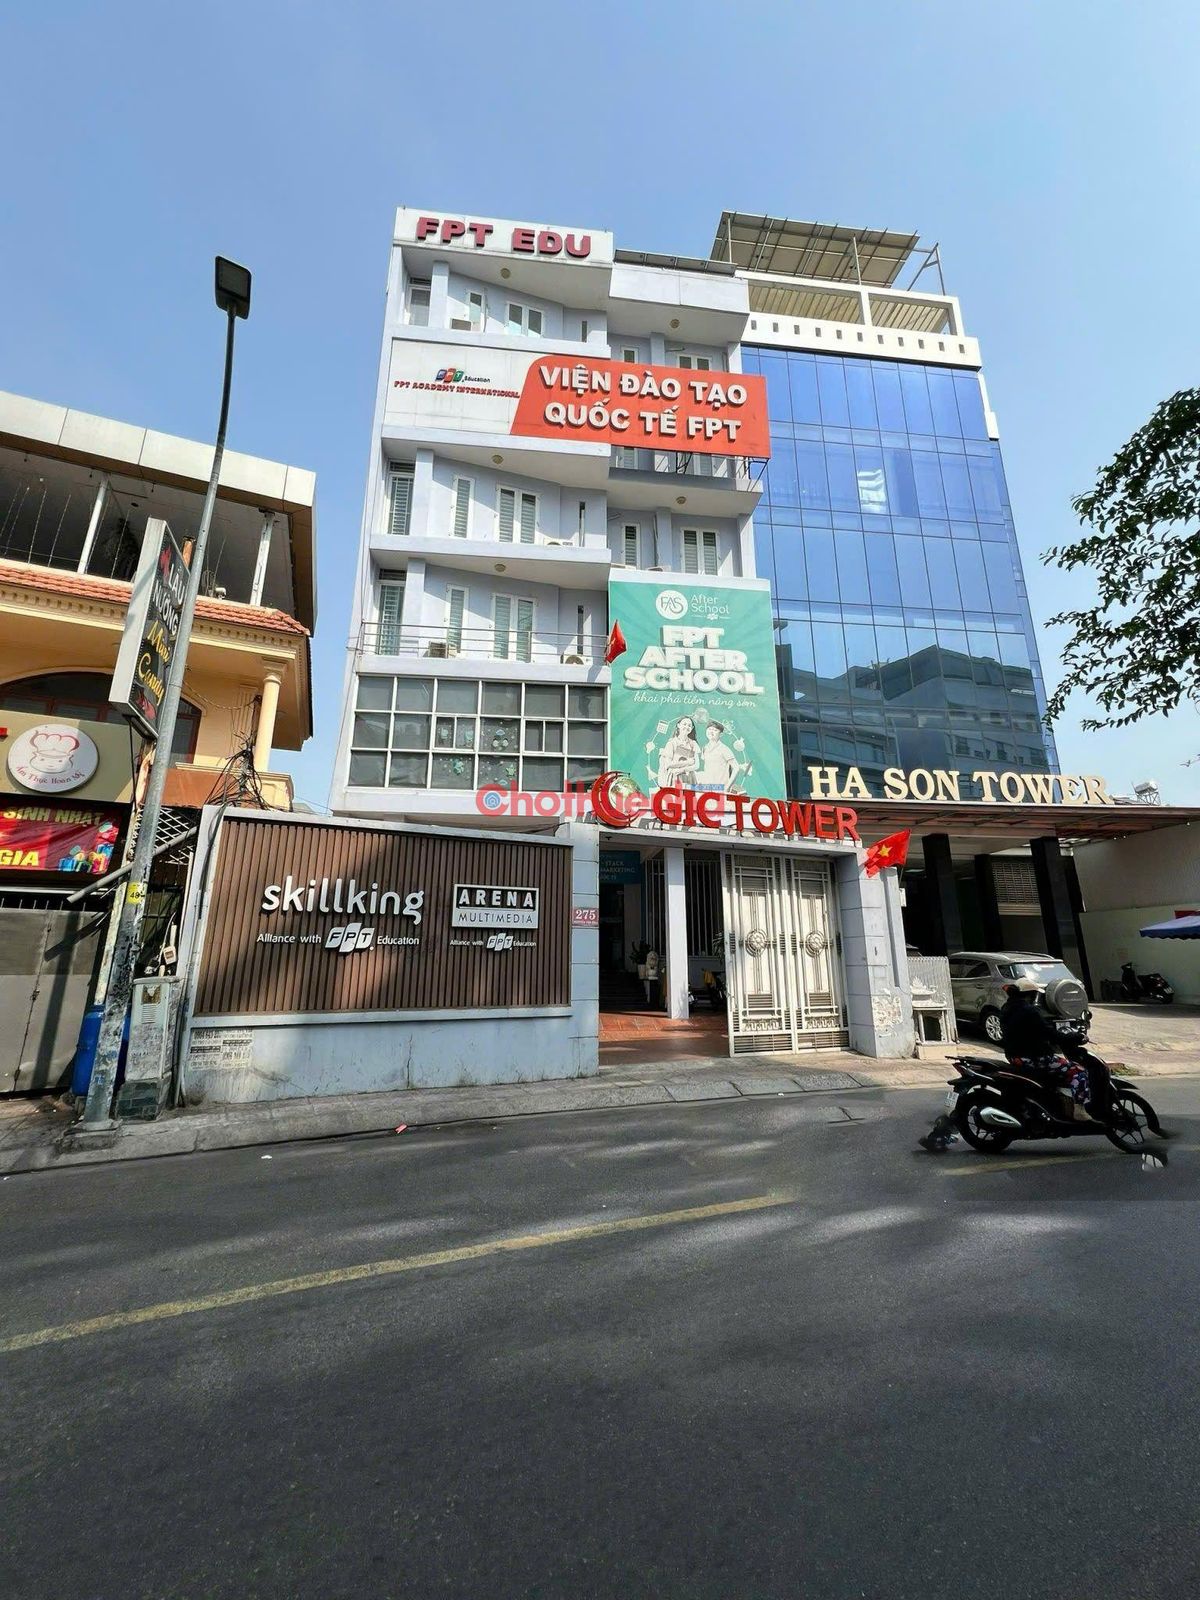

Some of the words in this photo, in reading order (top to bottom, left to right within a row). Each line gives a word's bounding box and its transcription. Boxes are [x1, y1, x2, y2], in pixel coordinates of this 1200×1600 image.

[416, 217, 493, 247] FPT
[512, 228, 591, 258] EDU
[435, 368, 464, 383] FPT
[464, 375, 491, 383] Education
[412, 382, 455, 392] ACADEMY
[456, 386, 520, 399] INTERNATIONAL
[540, 364, 611, 396] VIỆN
[620, 370, 681, 398] ĐÀO
[689, 381, 747, 409] TẠO
[545, 397, 630, 431] QUỐC
[640, 405, 678, 436] TẾ
[687, 416, 741, 442] FPT
[660, 596, 684, 614] FAS
[690, 593, 719, 605] After
[690, 602, 729, 614] School
[147, 620, 171, 663] Mini
[662, 625, 724, 648] FPT
[638, 645, 748, 671] AFTER
[624, 666, 765, 695] SCHOOL
[634, 691, 658, 703] khai
[659, 691, 681, 705] phá
[807, 766, 872, 799] HA
[883, 768, 960, 801] SON
[972, 771, 1115, 805] TOWER
[3, 806, 51, 821] SINH
[653, 787, 721, 828] GIC
[726, 795, 860, 841] TOWER
[0, 849, 40, 866] GIA
[261, 875, 424, 925] skillking
[459, 889, 533, 908] ARENA
[459, 912, 533, 924] MULTIMEDIA
[575, 909, 596, 921] 275
[256, 933, 295, 943] Alliance
[300, 934, 322, 944] with
[325, 923, 375, 953] FPT
[377, 935, 419, 945] Education
[487, 933, 513, 951] FPT
